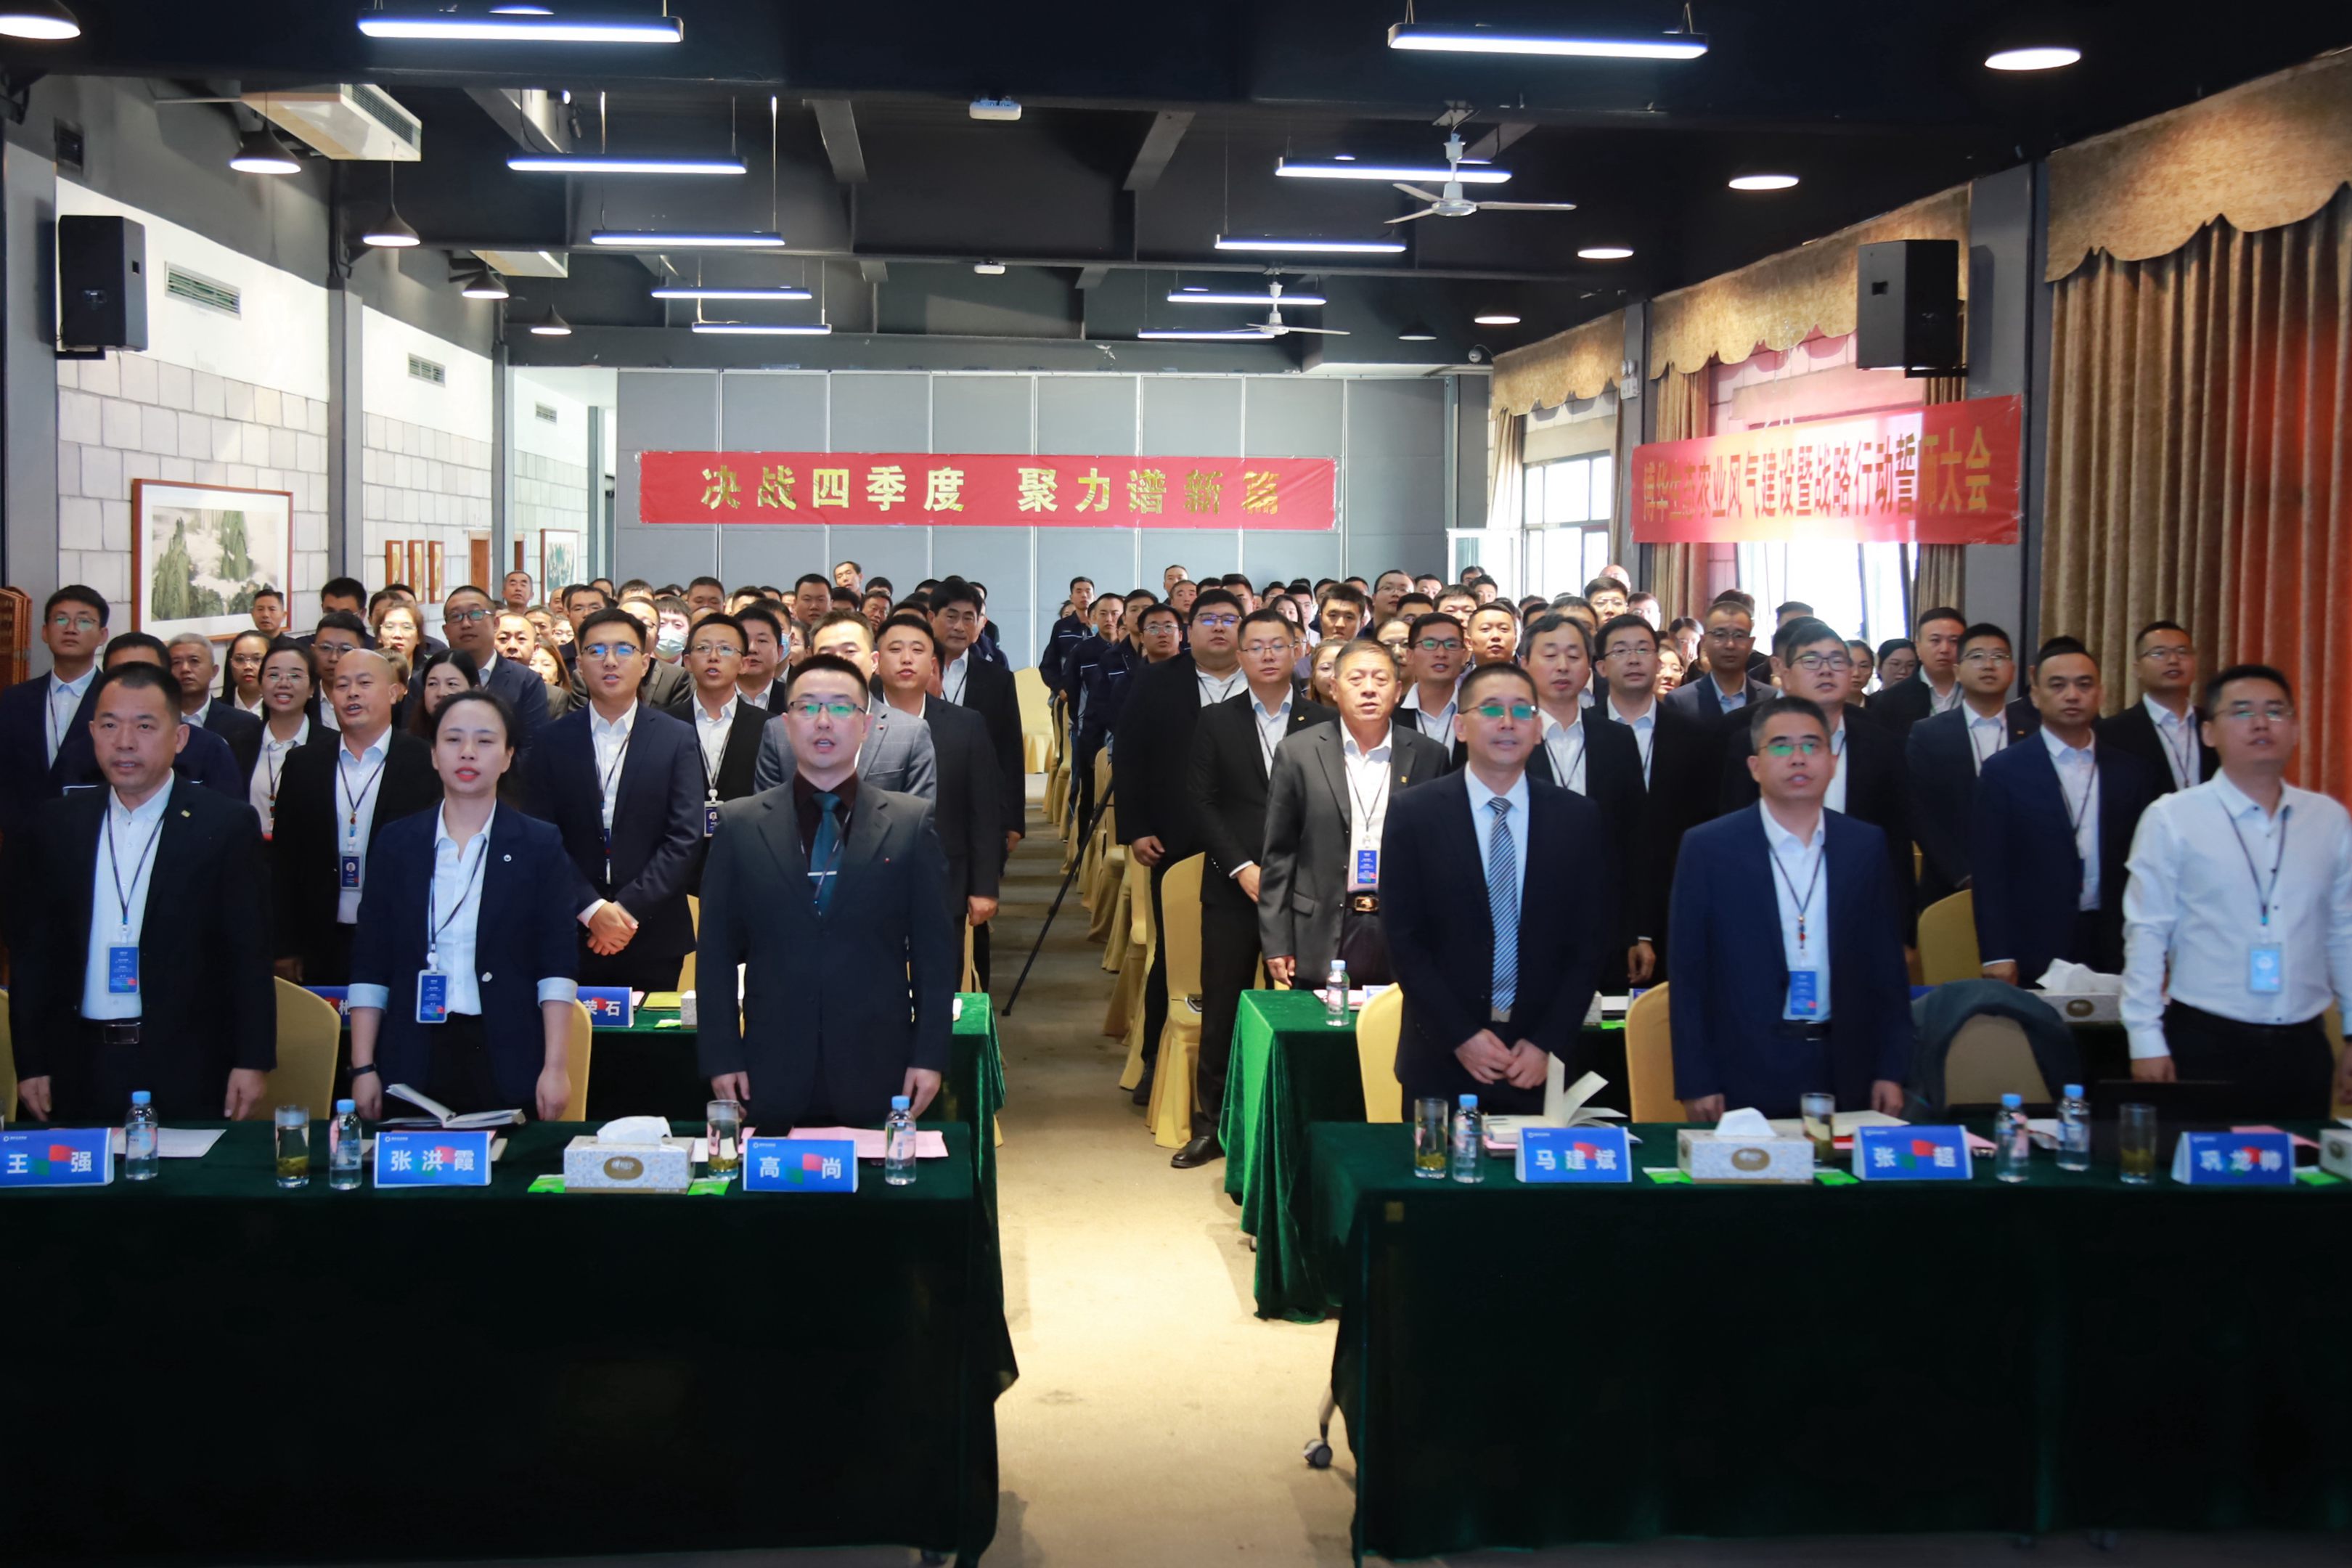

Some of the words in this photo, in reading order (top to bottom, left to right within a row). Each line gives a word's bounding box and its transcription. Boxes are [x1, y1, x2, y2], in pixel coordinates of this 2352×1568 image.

[701, 465, 964, 511] 决战四季度
[1017, 467, 1281, 515] 聚力谱新篇
[7, 1151, 91, 1174] 王强
[391, 1149, 475, 1171] 张洪霞
[759, 1156, 842, 1180] 高尚
